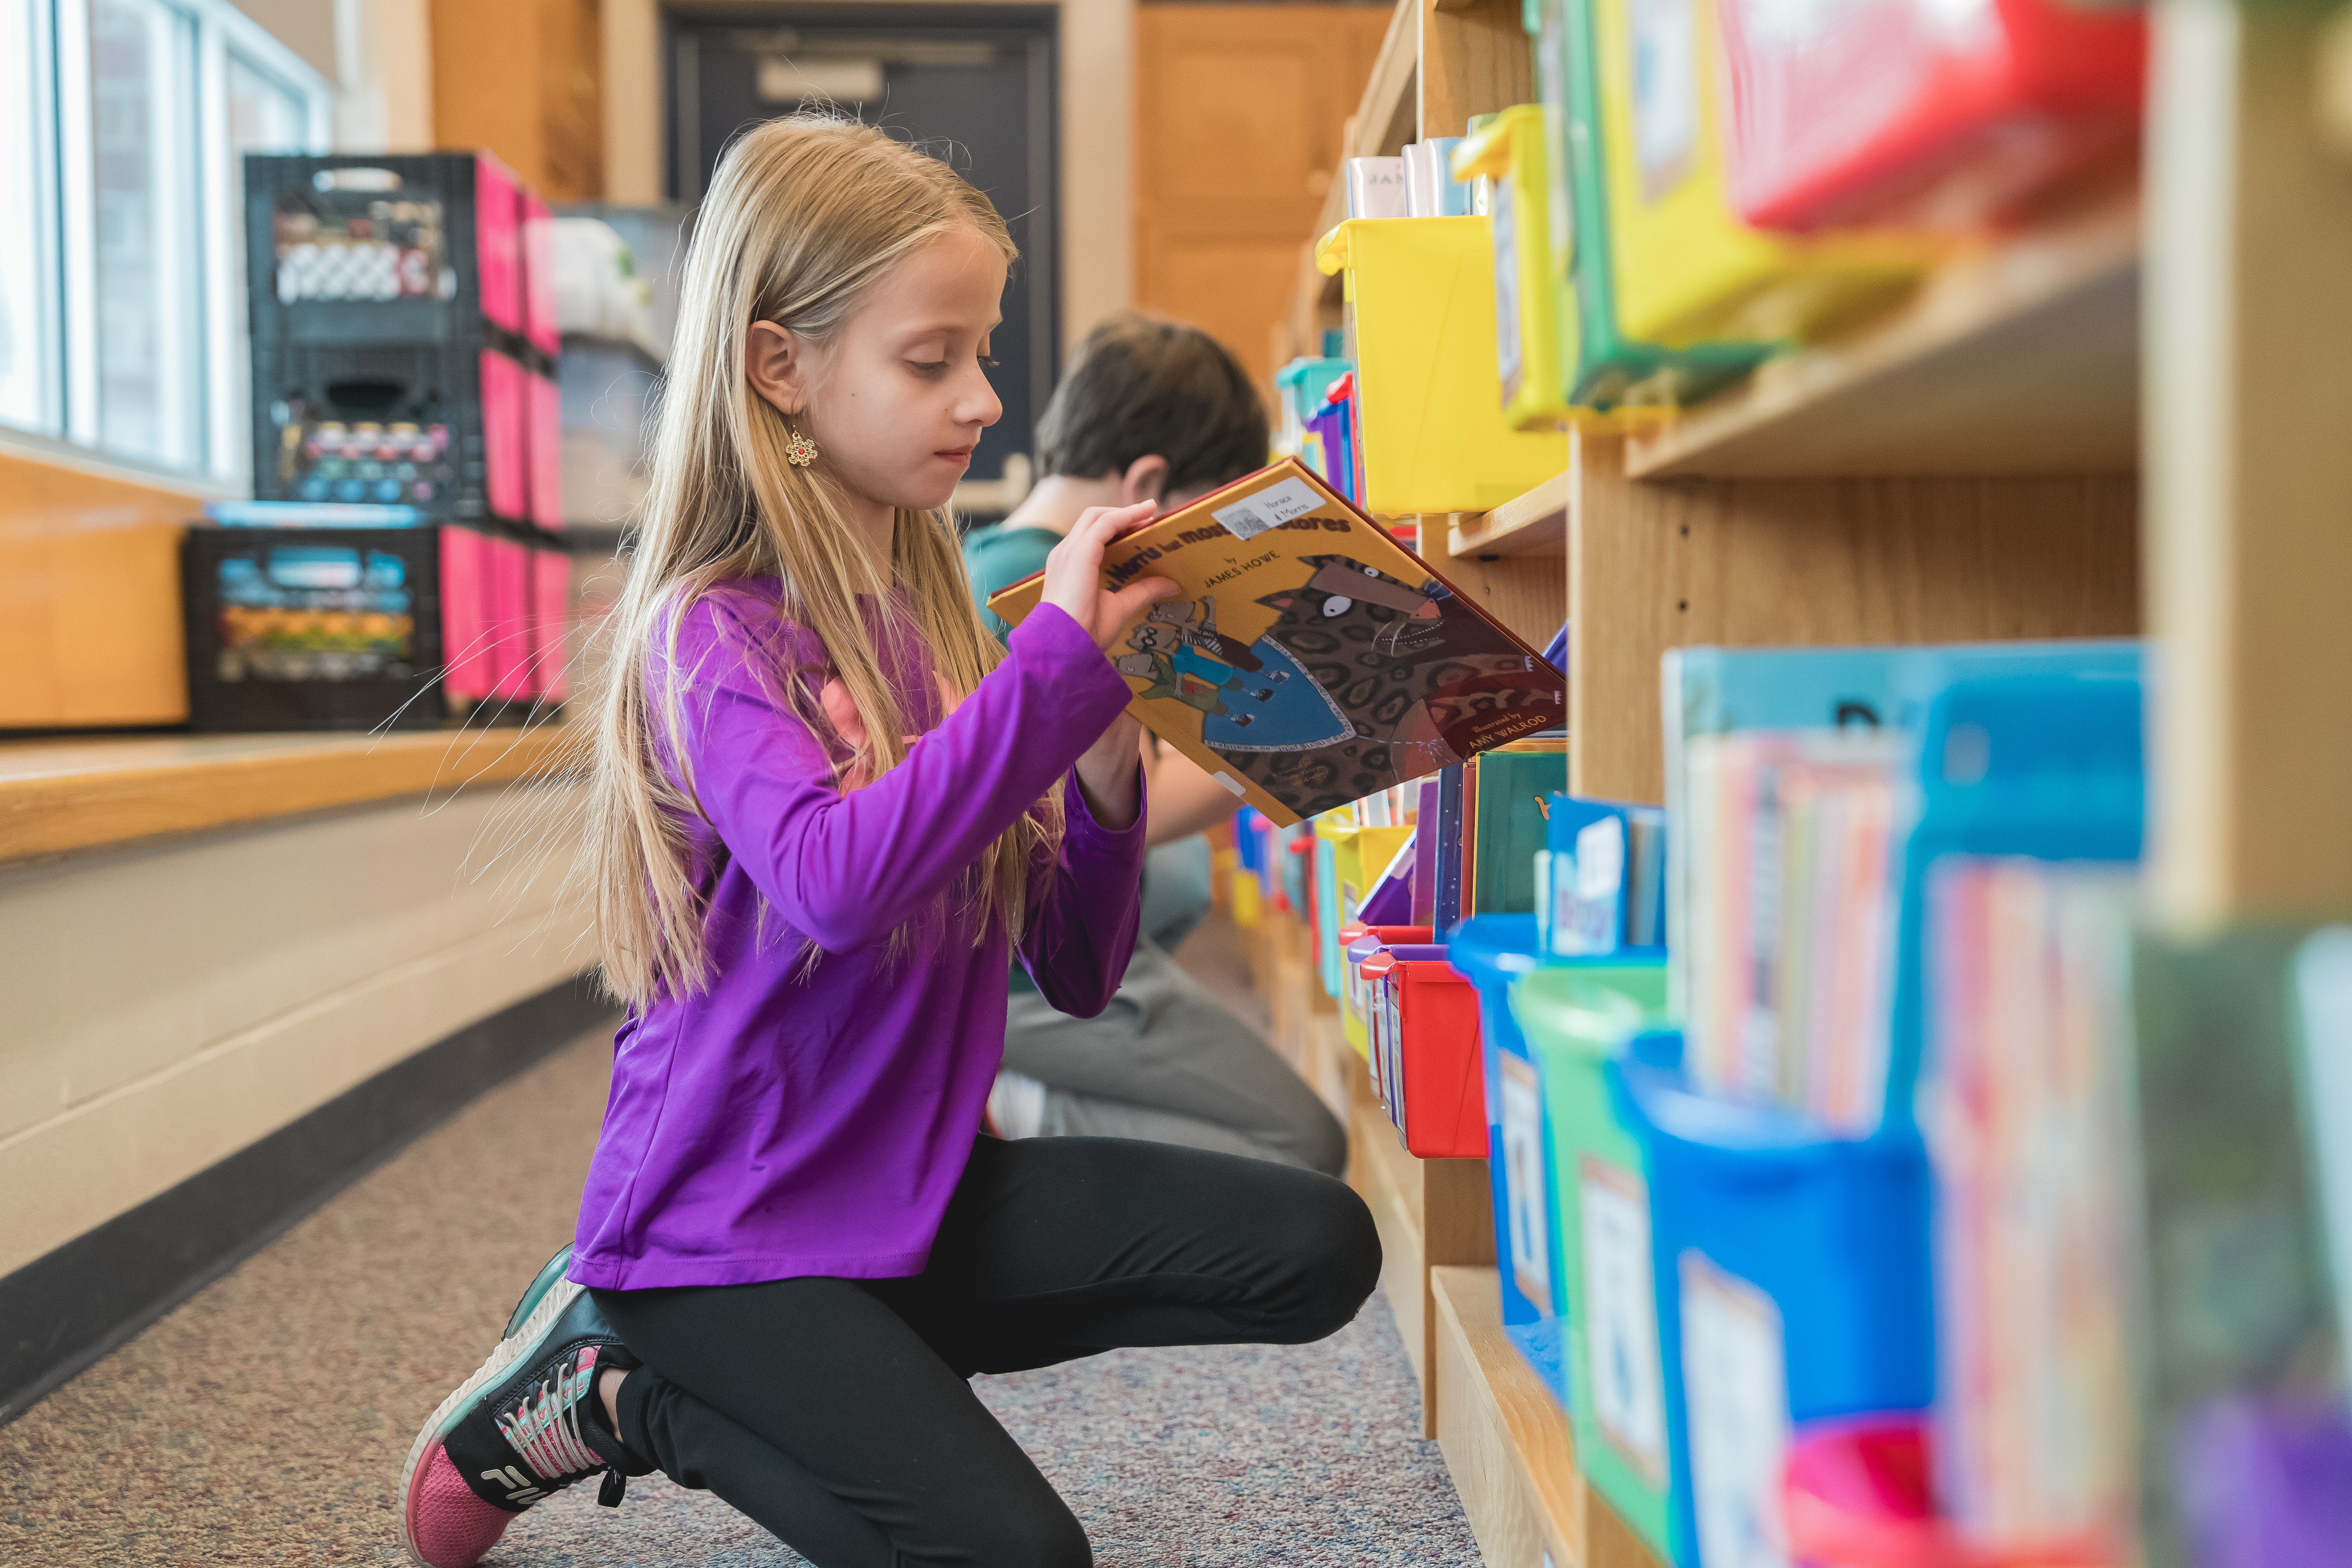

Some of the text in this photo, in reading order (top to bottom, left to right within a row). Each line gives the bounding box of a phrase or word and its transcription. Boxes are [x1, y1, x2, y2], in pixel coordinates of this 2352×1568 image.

[1177, 523, 1232, 545] most
[1204, 550, 1281, 589] JAMES HOWE
[1469, 715, 1547, 749] AMY WALROD
[1471, 714, 1511, 733] illustrated
